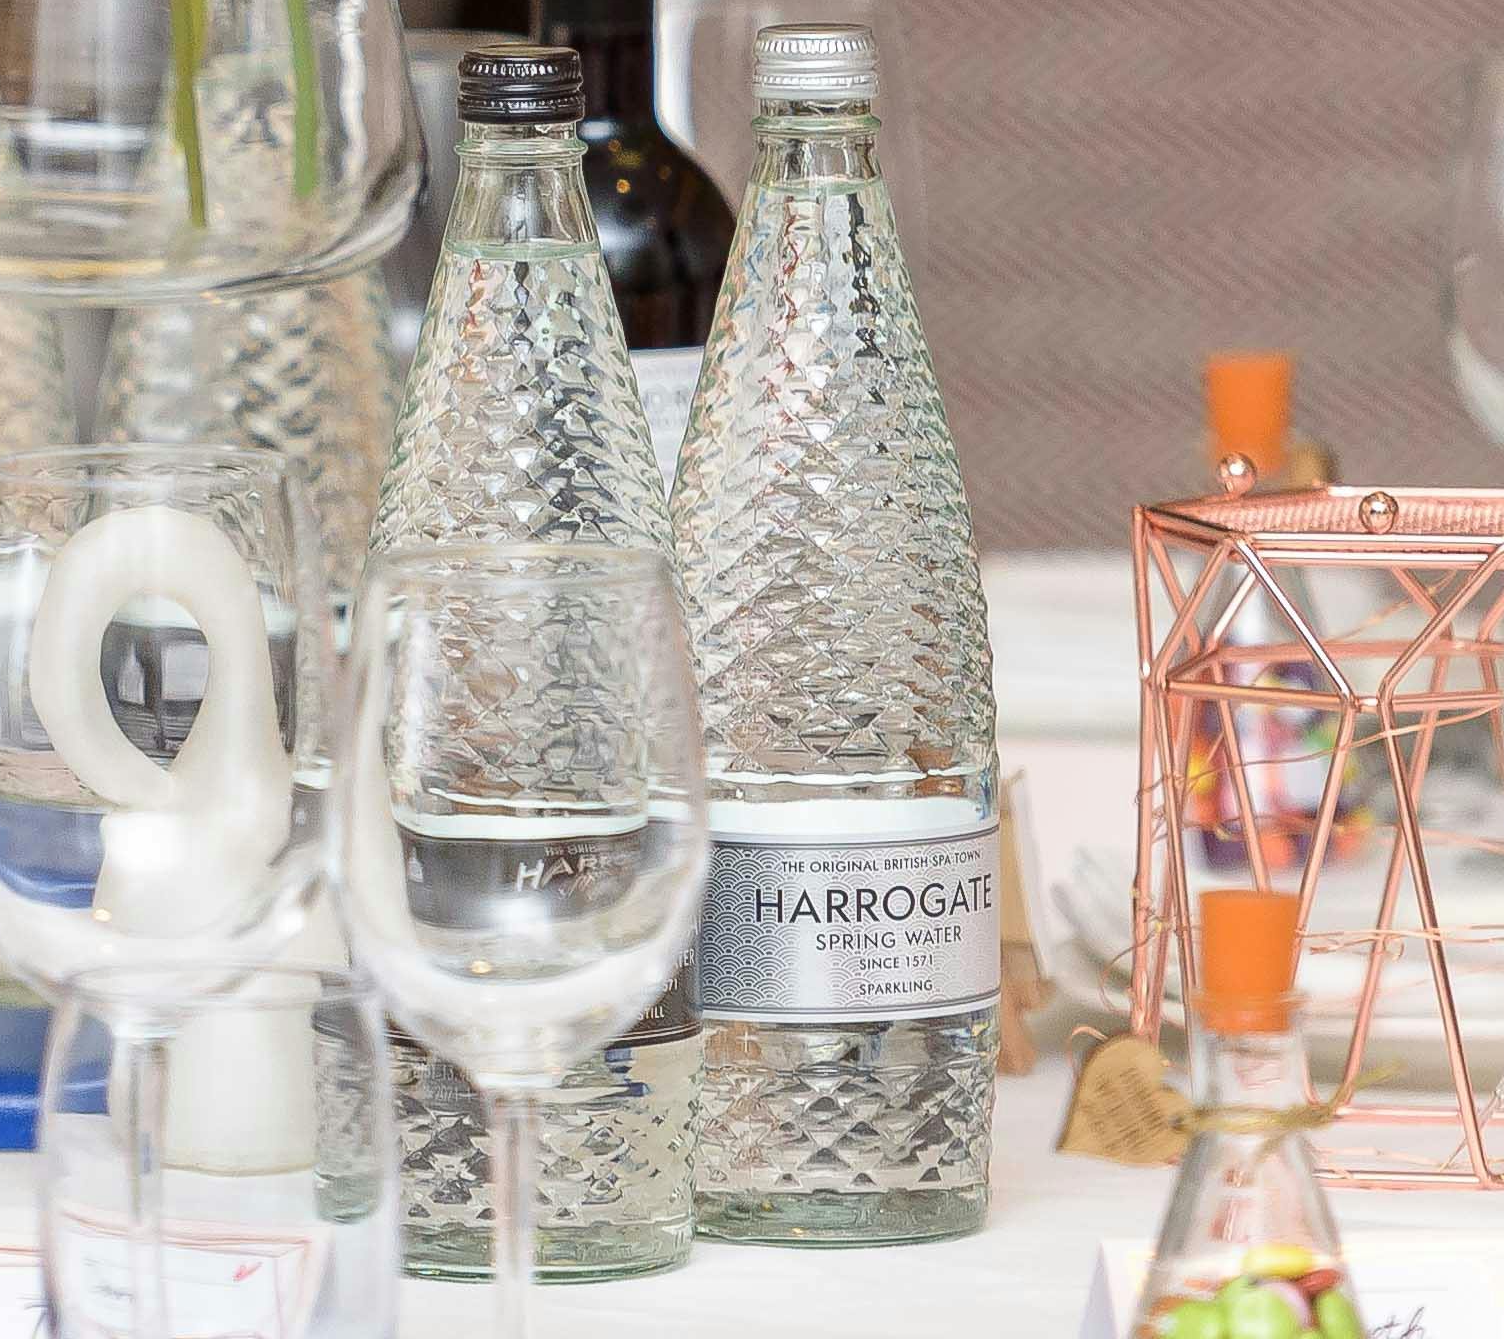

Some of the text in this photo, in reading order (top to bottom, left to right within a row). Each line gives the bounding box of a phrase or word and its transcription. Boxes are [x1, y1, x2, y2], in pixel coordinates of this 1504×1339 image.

[782, 850, 981, 873] THE ORIGINAL BRITISH SPA TOWN
[755, 873, 992, 924] HARROGATE
[816, 925, 962, 950] SPRING WATER
[859, 955, 933, 970] SINCE 1571
[859, 980, 933, 996] SPARKLING
